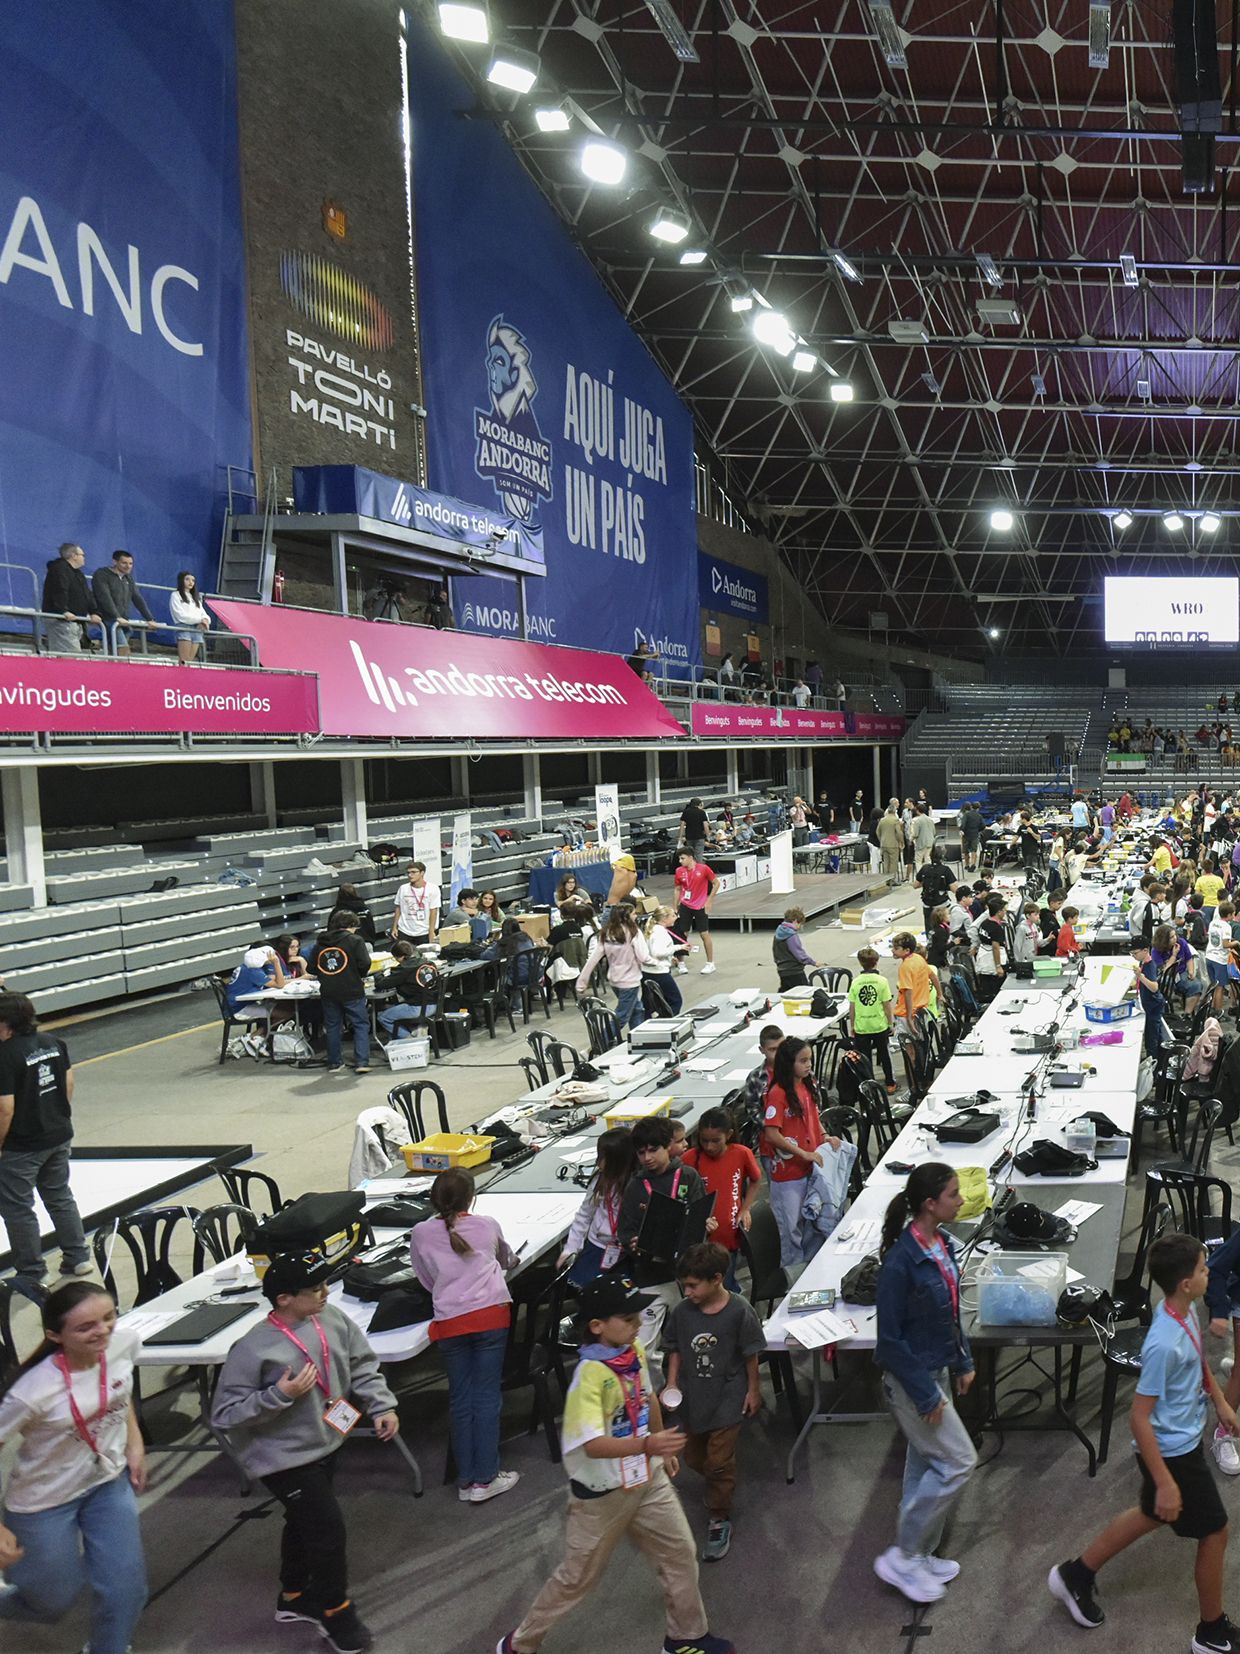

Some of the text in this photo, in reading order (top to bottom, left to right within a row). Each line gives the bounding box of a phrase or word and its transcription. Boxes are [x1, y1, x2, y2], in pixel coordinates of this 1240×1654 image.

[286, 329, 392, 390] PAVELLÓ
[288, 356, 394, 420] TONI
[478, 416, 550, 462] MORABANC
[564, 363, 668, 486] AQUÍ JUGA
[479, 439, 550, 492] ANDORRA
[415, 500, 469, 530] andorra
[565, 464, 646, 565] UN PAÍS
[722, 575, 757, 603] Andorra
[1171, 602, 1203, 615] WRO
[648, 634, 688, 658] Andorra
[163, 687, 271, 713] Bienvenidos
[404, 663, 628, 705] andorra telecom
